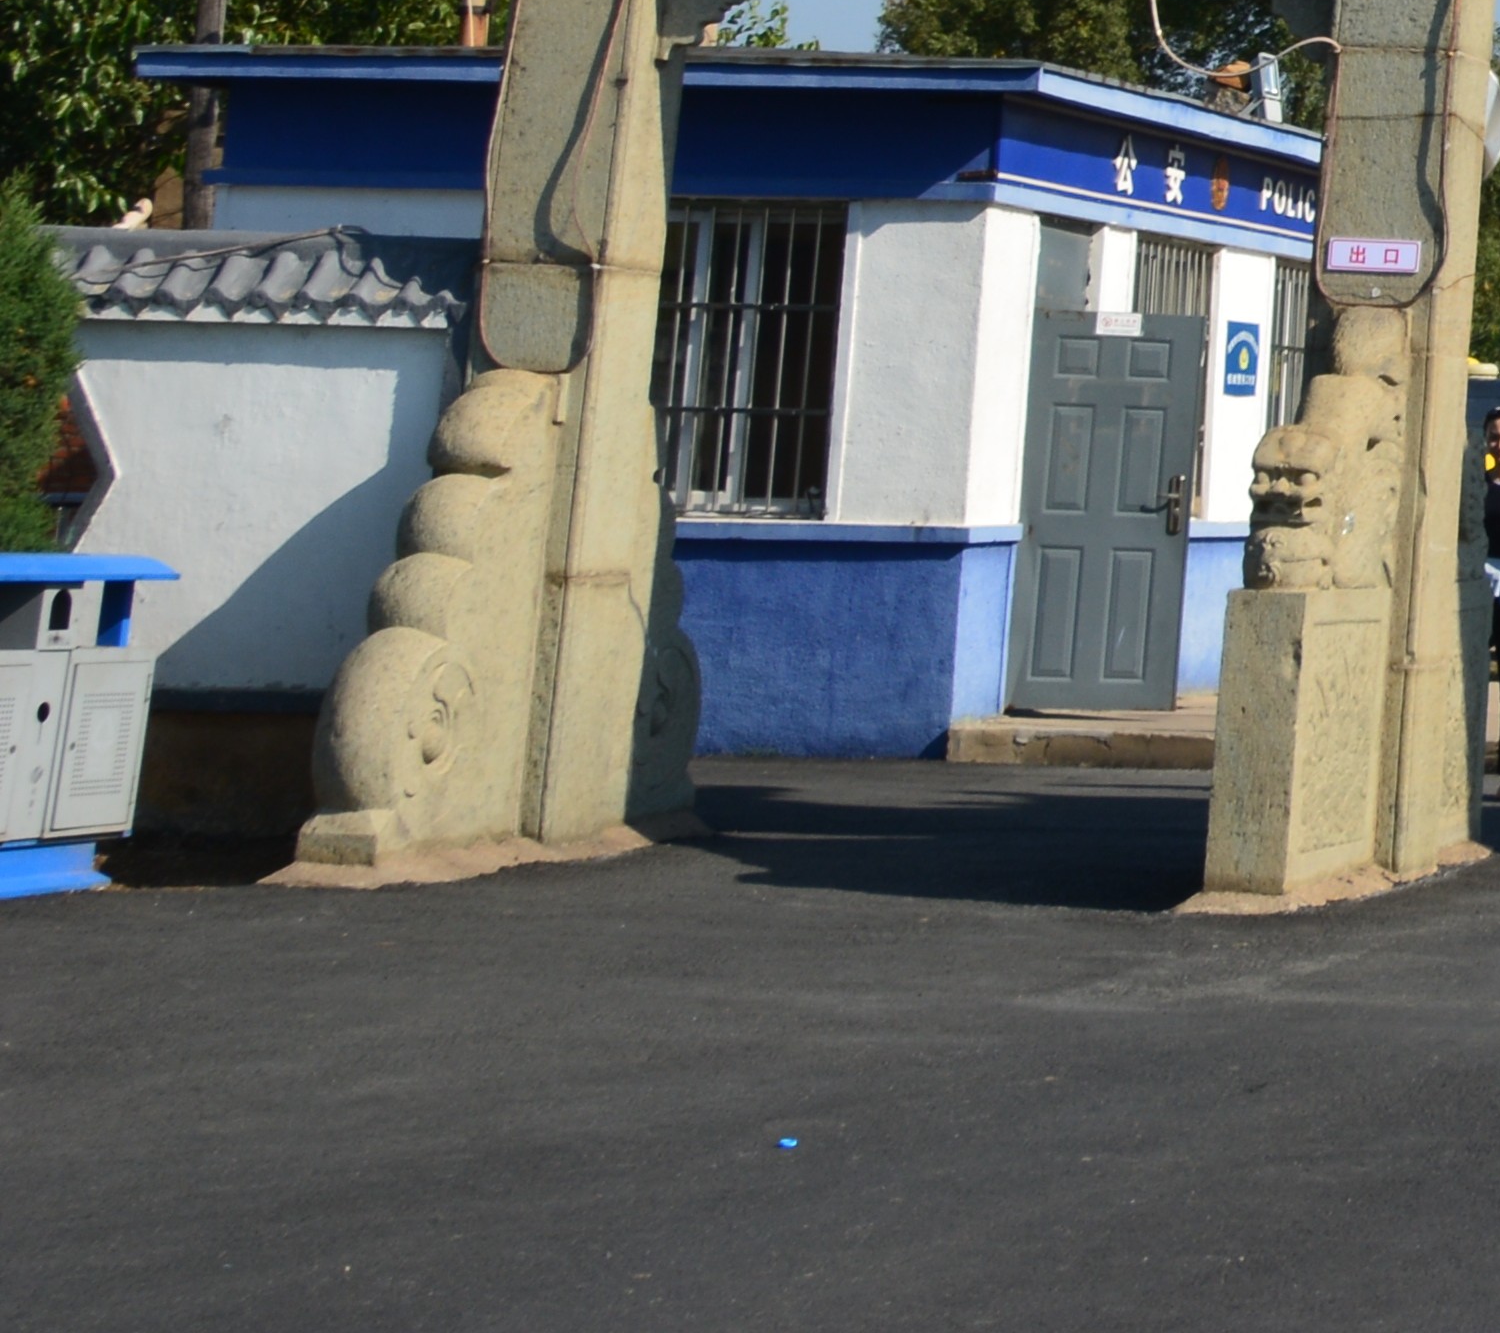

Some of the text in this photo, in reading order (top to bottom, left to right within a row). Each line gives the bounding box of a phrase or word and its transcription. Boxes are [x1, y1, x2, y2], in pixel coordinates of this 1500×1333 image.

[1113, 134, 1316, 223] 公安 POLIC
[1349, 244, 1400, 266] 出口
